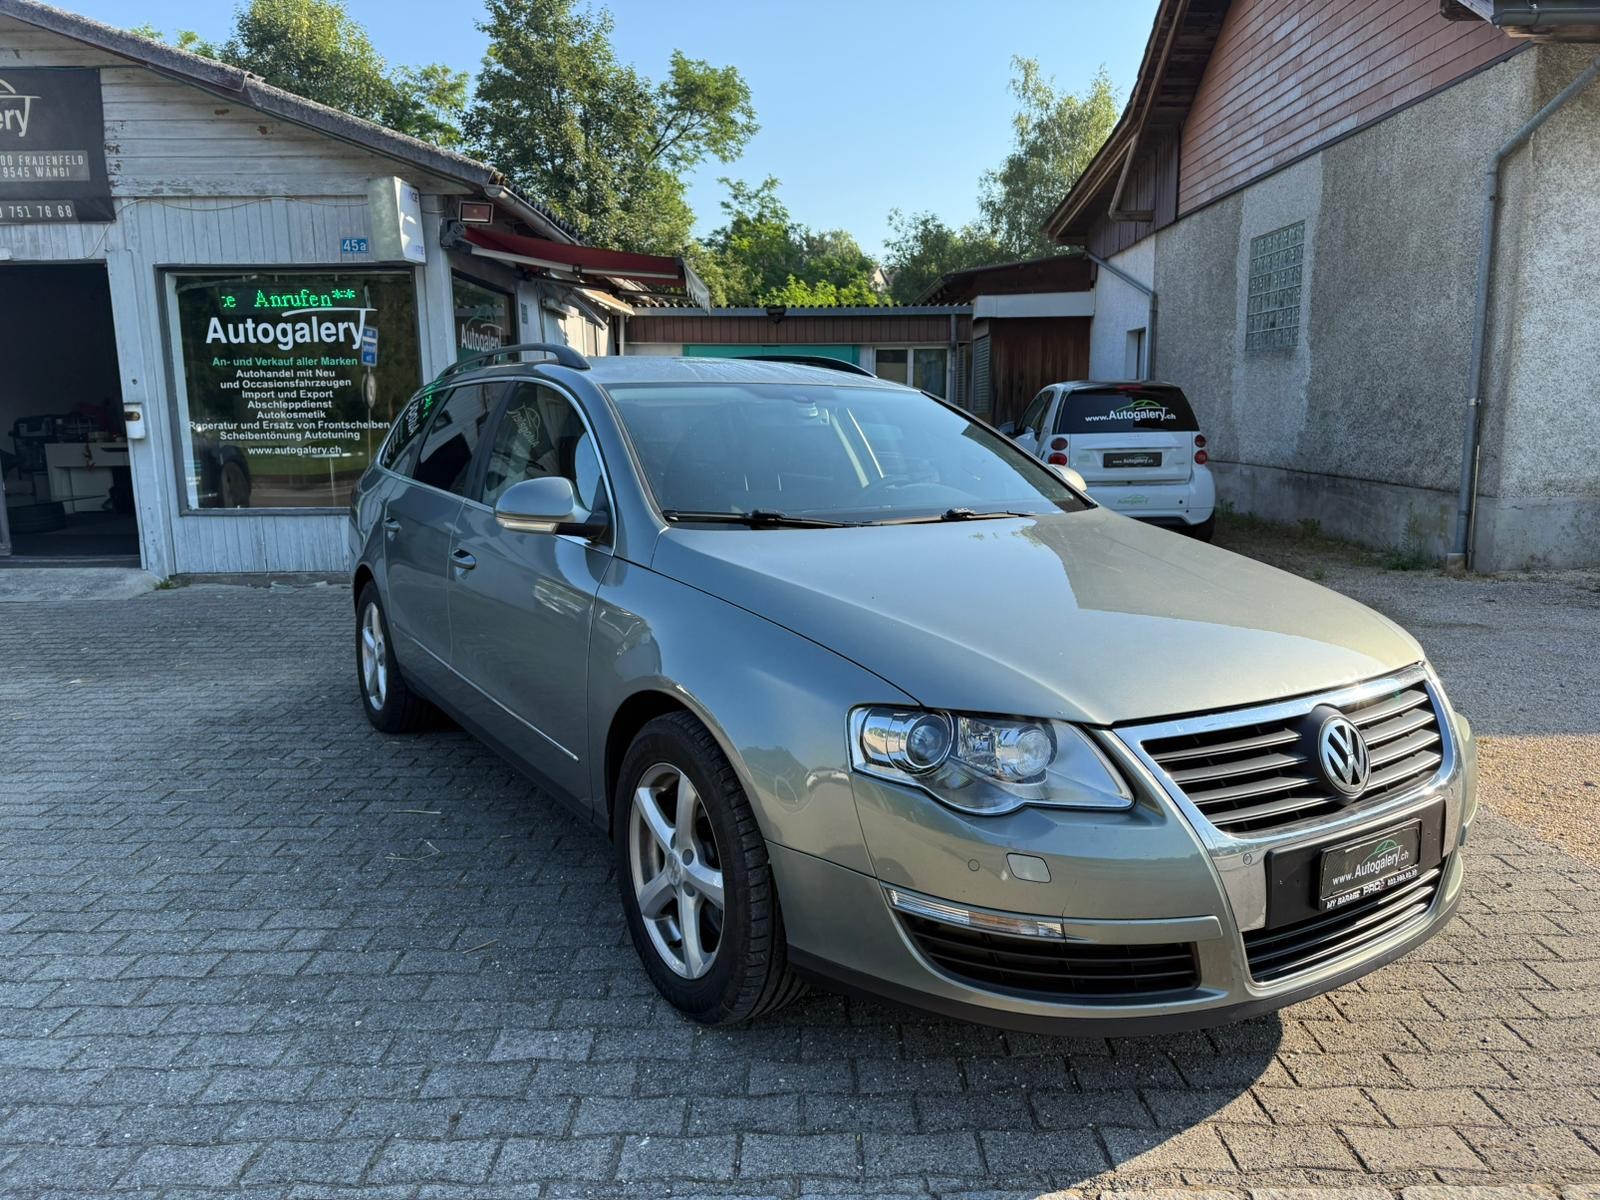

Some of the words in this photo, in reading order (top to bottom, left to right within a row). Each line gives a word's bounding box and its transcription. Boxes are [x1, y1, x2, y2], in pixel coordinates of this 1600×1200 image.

[0, 96, 30, 137] ry
[19, 155, 84, 166] FRAUENFELD
[3, 166, 30, 178] 9545
[9, 205, 32, 218] 751
[37, 205, 52, 218] 76
[57, 205, 73, 218] 68
[343, 239, 367, 251] 45a
[206, 309, 367, 351] Autogalery
[212, 357, 230, 367] An-
[233, 357, 252, 367] und
[254, 357, 294, 367] Verkauf
[296, 356, 318, 366] aller
[320, 356, 358, 366] Marken
[236, 369, 294, 378] Autohandel
[296, 369, 313, 378] mit
[315, 368, 336, 377] Neu
[220, 380, 240, 389] und
[242, 379, 352, 389] Occasionsfahrzeugen
[242, 390, 275, 400] Import
[277, 390, 297, 399] und
[299, 389, 334, 400] Export
[247, 400, 333, 410] Abschleppdienst
[256, 411, 327, 420] Autokosmetik
[1085, 406, 1176, 421] www.Autogalery.ch
[240, 421, 260, 430] und
[262, 420, 295, 430] Ersatz
[297, 421, 316, 430] von
[317, 420, 391, 429] Frontscheiben
[220, 431, 302, 441] Scheibentönung
[304, 430, 361, 441] Autotuning
[247, 446, 342, 456] www.autogalery.ch
